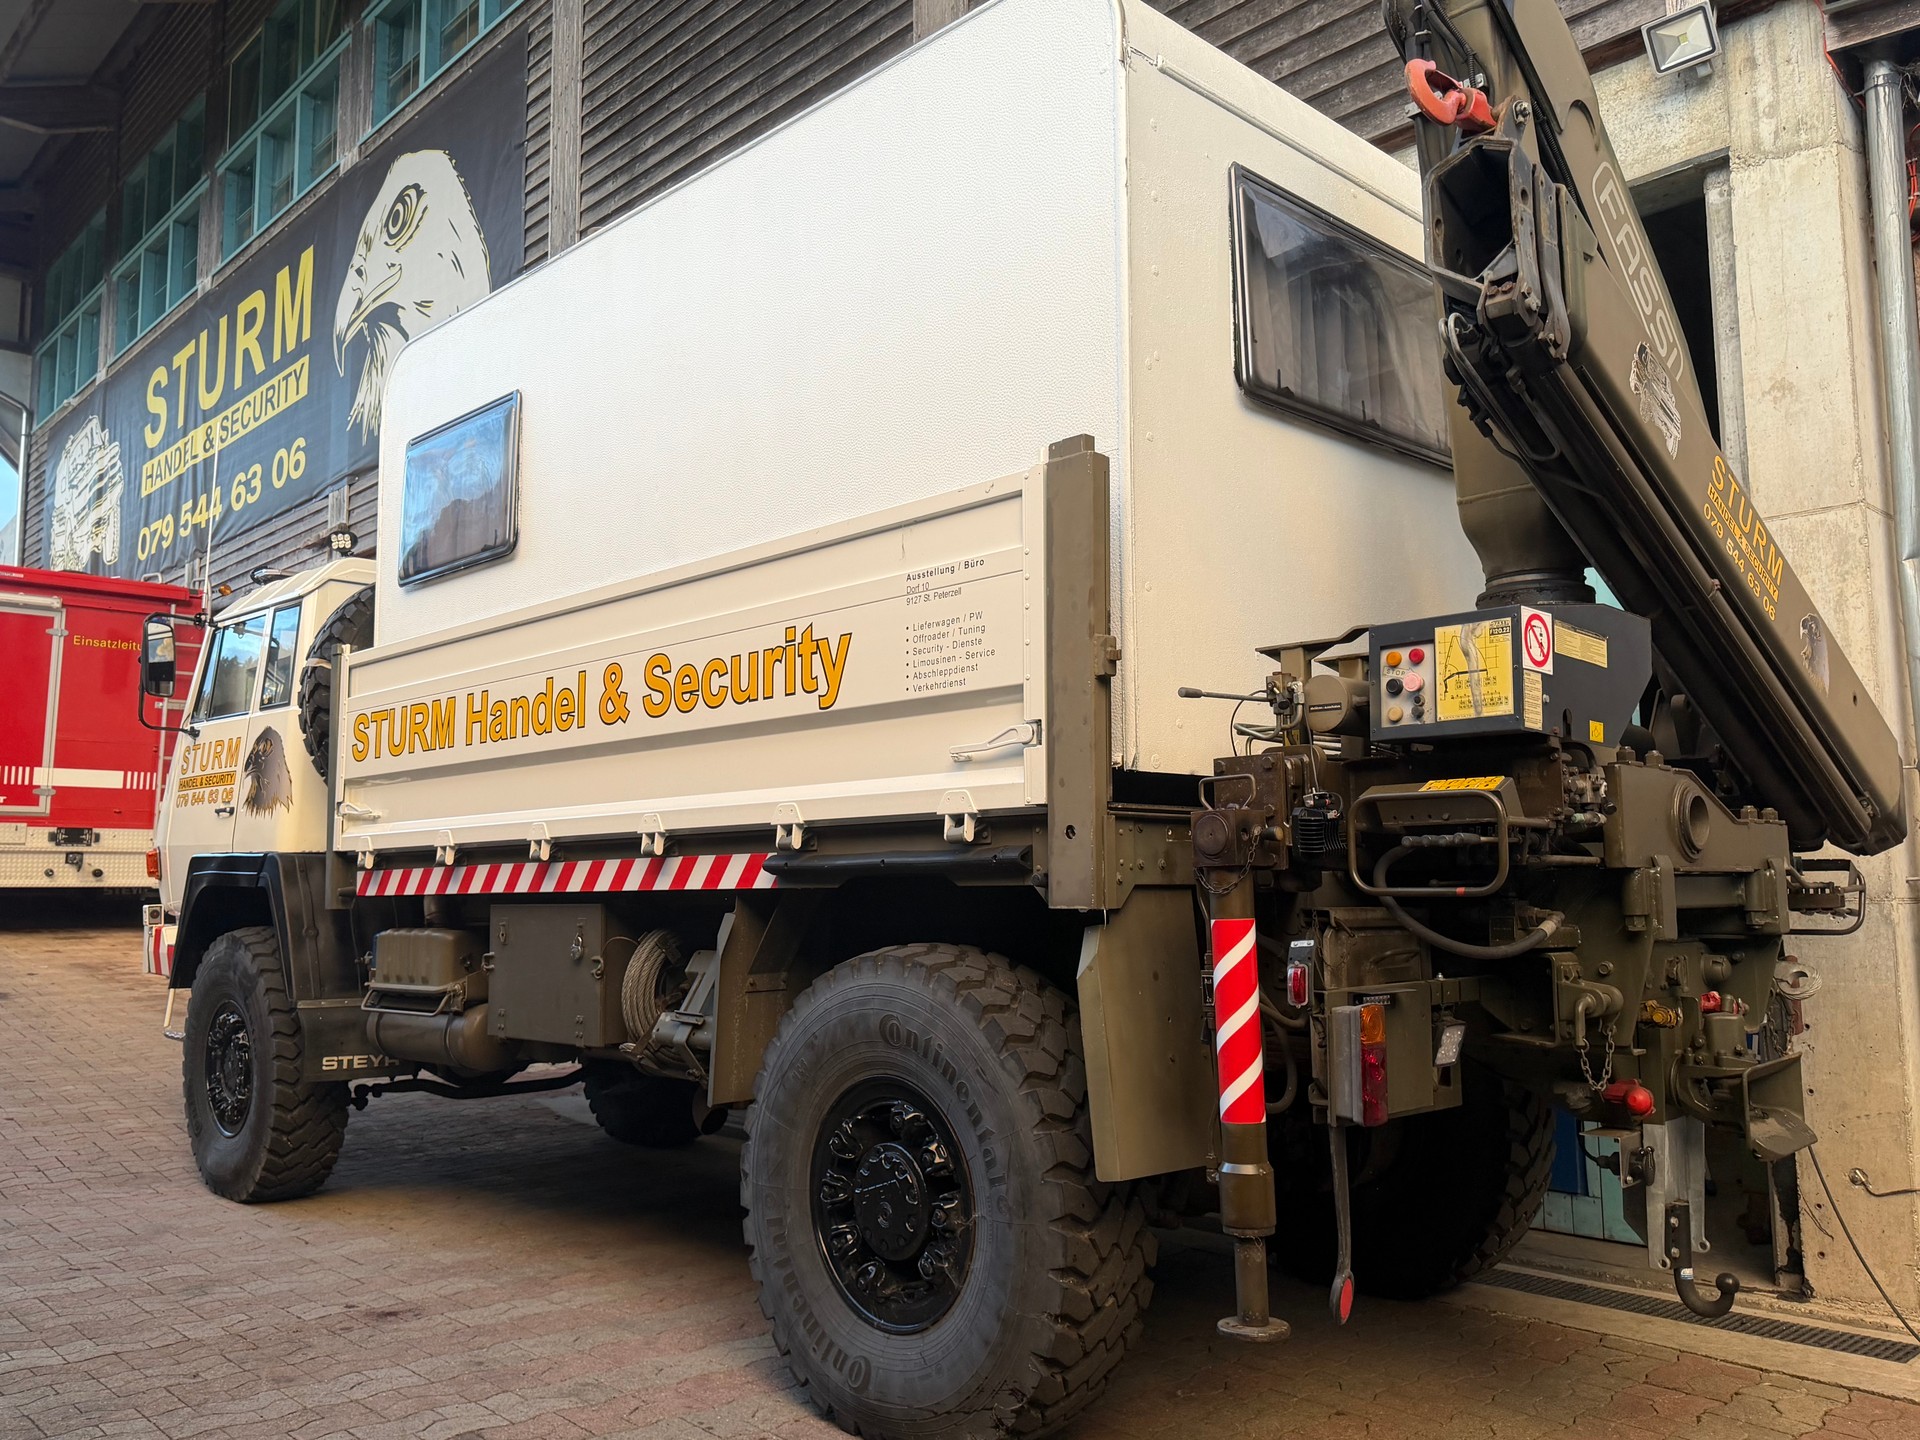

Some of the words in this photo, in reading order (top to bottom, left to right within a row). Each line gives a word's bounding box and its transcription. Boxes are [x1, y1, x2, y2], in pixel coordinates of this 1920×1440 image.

[1599, 178, 1678, 369] FASSI
[144, 244, 314, 449] STURM
[145, 434, 199, 488] HANDEL
[203, 425, 215, 452] &
[219, 362, 306, 444] SECURITY
[137, 513, 174, 561] 079
[179, 485, 222, 537] 544
[230, 462, 262, 512] 63
[271, 437, 306, 489] 06
[1711, 455, 1784, 586] STURM
[1709, 485, 1737, 537] HANDEL
[1745, 545, 1778, 599] SECURITY
[906, 564, 955, 582] Ausstellung
[964, 558, 985, 570] Büro
[1703, 503, 1724, 539] 079
[1726, 537, 1745, 574] 544
[1747, 571, 1761, 598] 63
[1763, 595, 1776, 621] 06
[906, 584, 921, 595] Dorf
[922, 582, 930, 592] 10
[906, 595, 922, 606] 9127
[923, 593, 931, 603] St.
[933, 587, 962, 601] Peterzell
[913, 615, 960, 632] Lieferwagen
[969, 611, 983, 622] PW
[913, 630, 950, 644] Offroader
[958, 624, 986, 637] Tuning
[913, 644, 944, 656] Security
[952, 637, 983, 650] Dienste
[913, 655, 957, 669] Limousinen
[965, 648, 996, 660] Service
[913, 663, 979, 680] Abschleppdienst
[351, 697, 456, 763] STURM
[465, 669, 587, 747] Handel
[598, 662, 631, 726] &
[642, 622, 853, 719] Security
[913, 678, 966, 693] Verkehrdienst
[181, 737, 242, 775] STURM
[179, 776, 199, 790] HANDEL
[204, 772, 235, 786] SECURITY
[176, 792, 189, 808] 079
[190, 790, 205, 807] 544
[207, 788, 219, 804] 63
[221, 787, 234, 803] 06
[879, 1014, 1007, 1188] Continental
